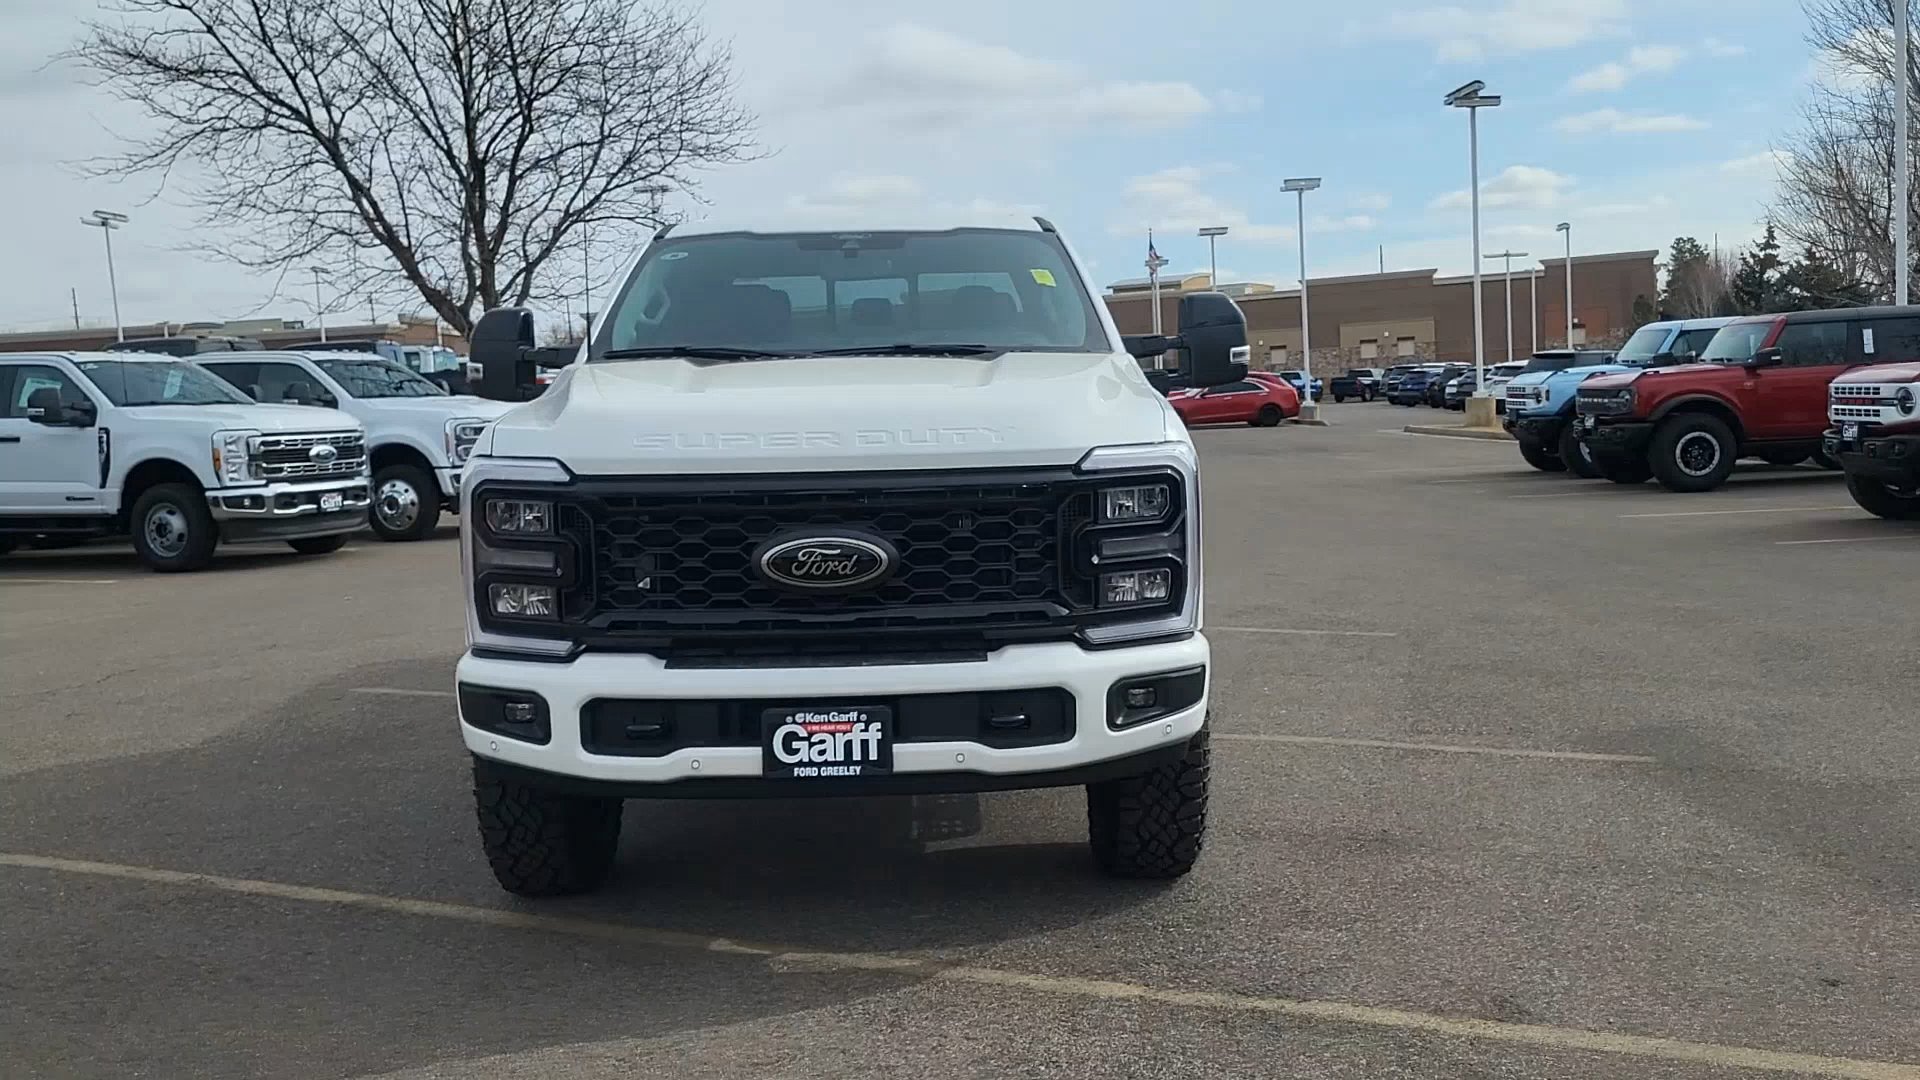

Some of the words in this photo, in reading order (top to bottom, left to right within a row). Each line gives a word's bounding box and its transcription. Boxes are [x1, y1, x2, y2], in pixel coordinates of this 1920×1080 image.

[632, 431, 841, 449] SUPER
[855, 427, 1014, 447] DUTY
[791, 548, 858, 576] Ford
[805, 712, 828, 722] Ken
[829, 711, 858, 721] Garff
[773, 722, 881, 763] Garff
[794, 767, 818, 777] FORD
[820, 766, 861, 777] GREELEY
